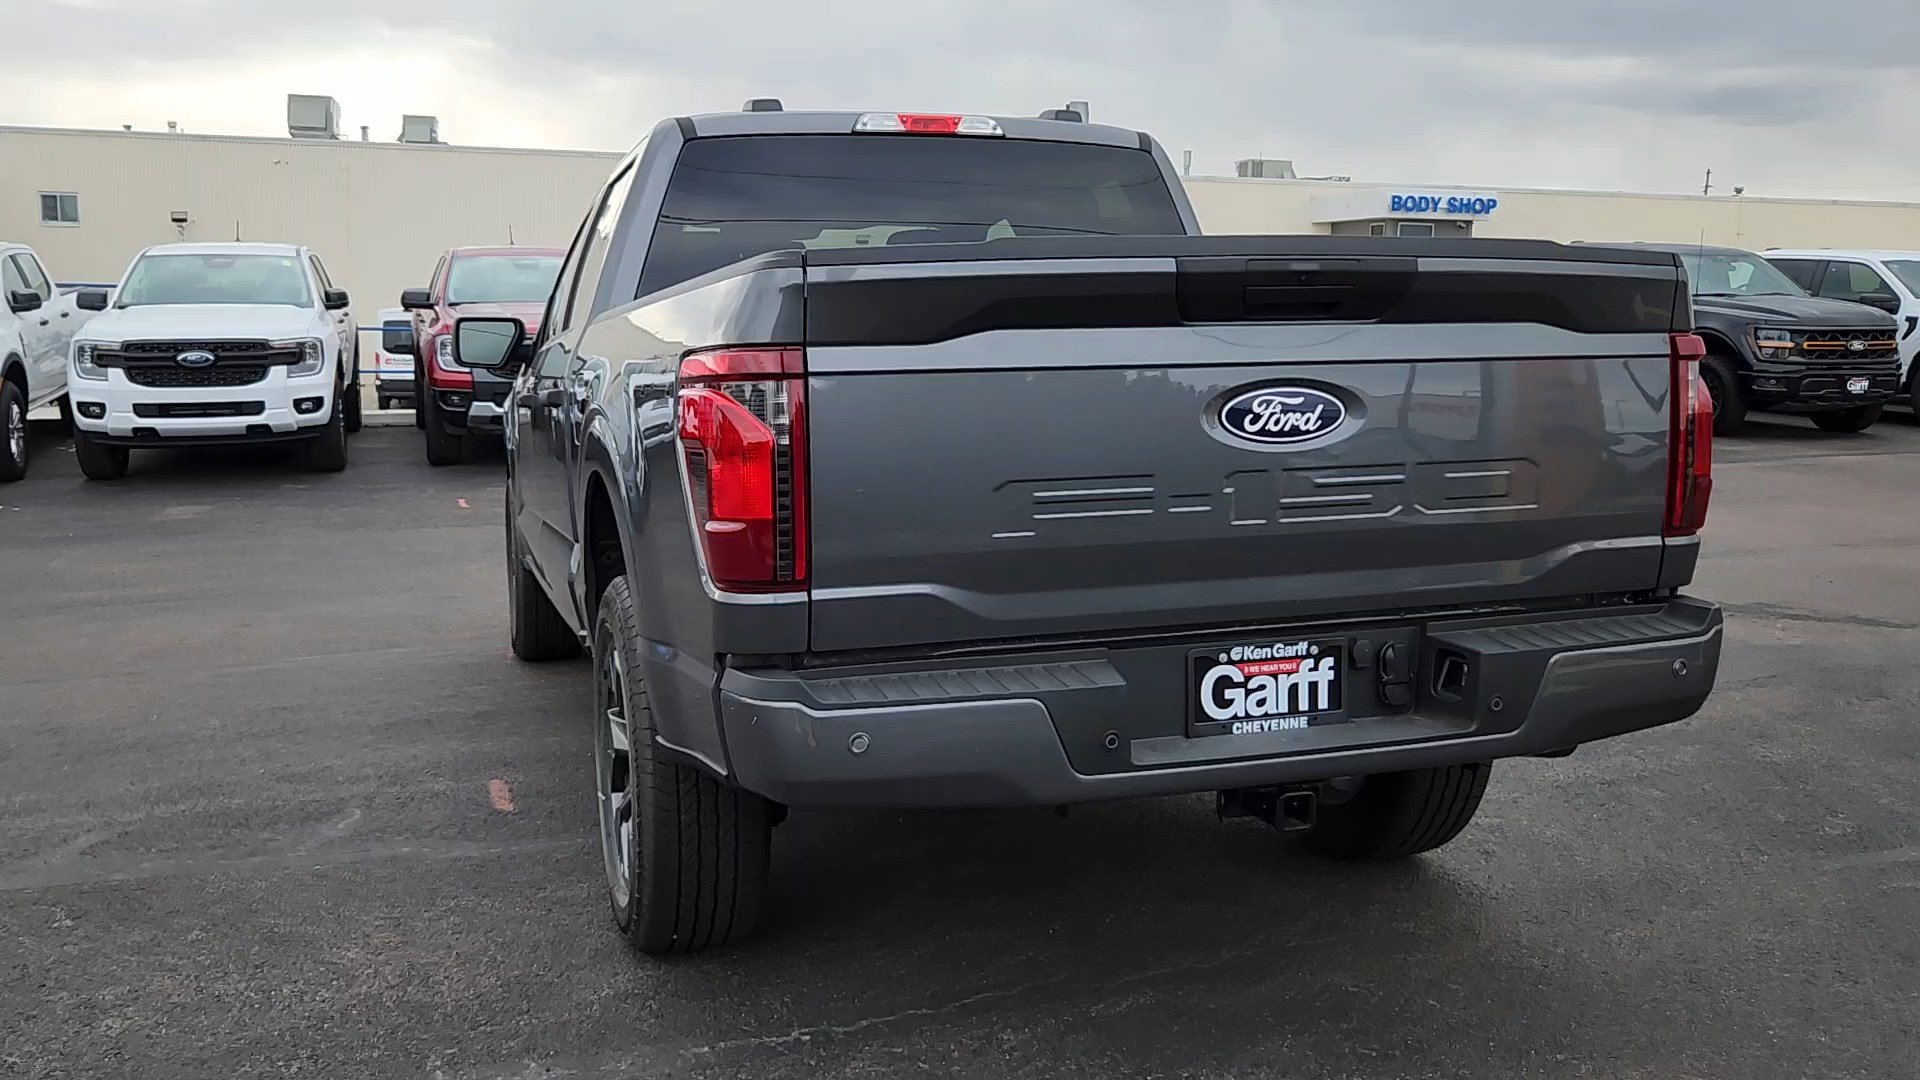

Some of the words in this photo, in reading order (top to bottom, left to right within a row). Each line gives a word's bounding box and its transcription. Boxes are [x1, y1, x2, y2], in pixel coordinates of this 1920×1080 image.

[1391, 195, 1442, 213] BODY
[1446, 196, 1498, 215] SHOP
[1243, 395, 1323, 433] Ford
[992, 457, 1539, 538] F-150
[1243, 645, 1272, 661] Ken
[1273, 641, 1309, 657] Garff
[1249, 665, 1260, 673] WE
[1260, 664, 1278, 672] HEAR
[1278, 663, 1292, 671] YOU
[1201, 656, 1335, 720] Garff
[1232, 717, 1308, 735] CHEYENNE
